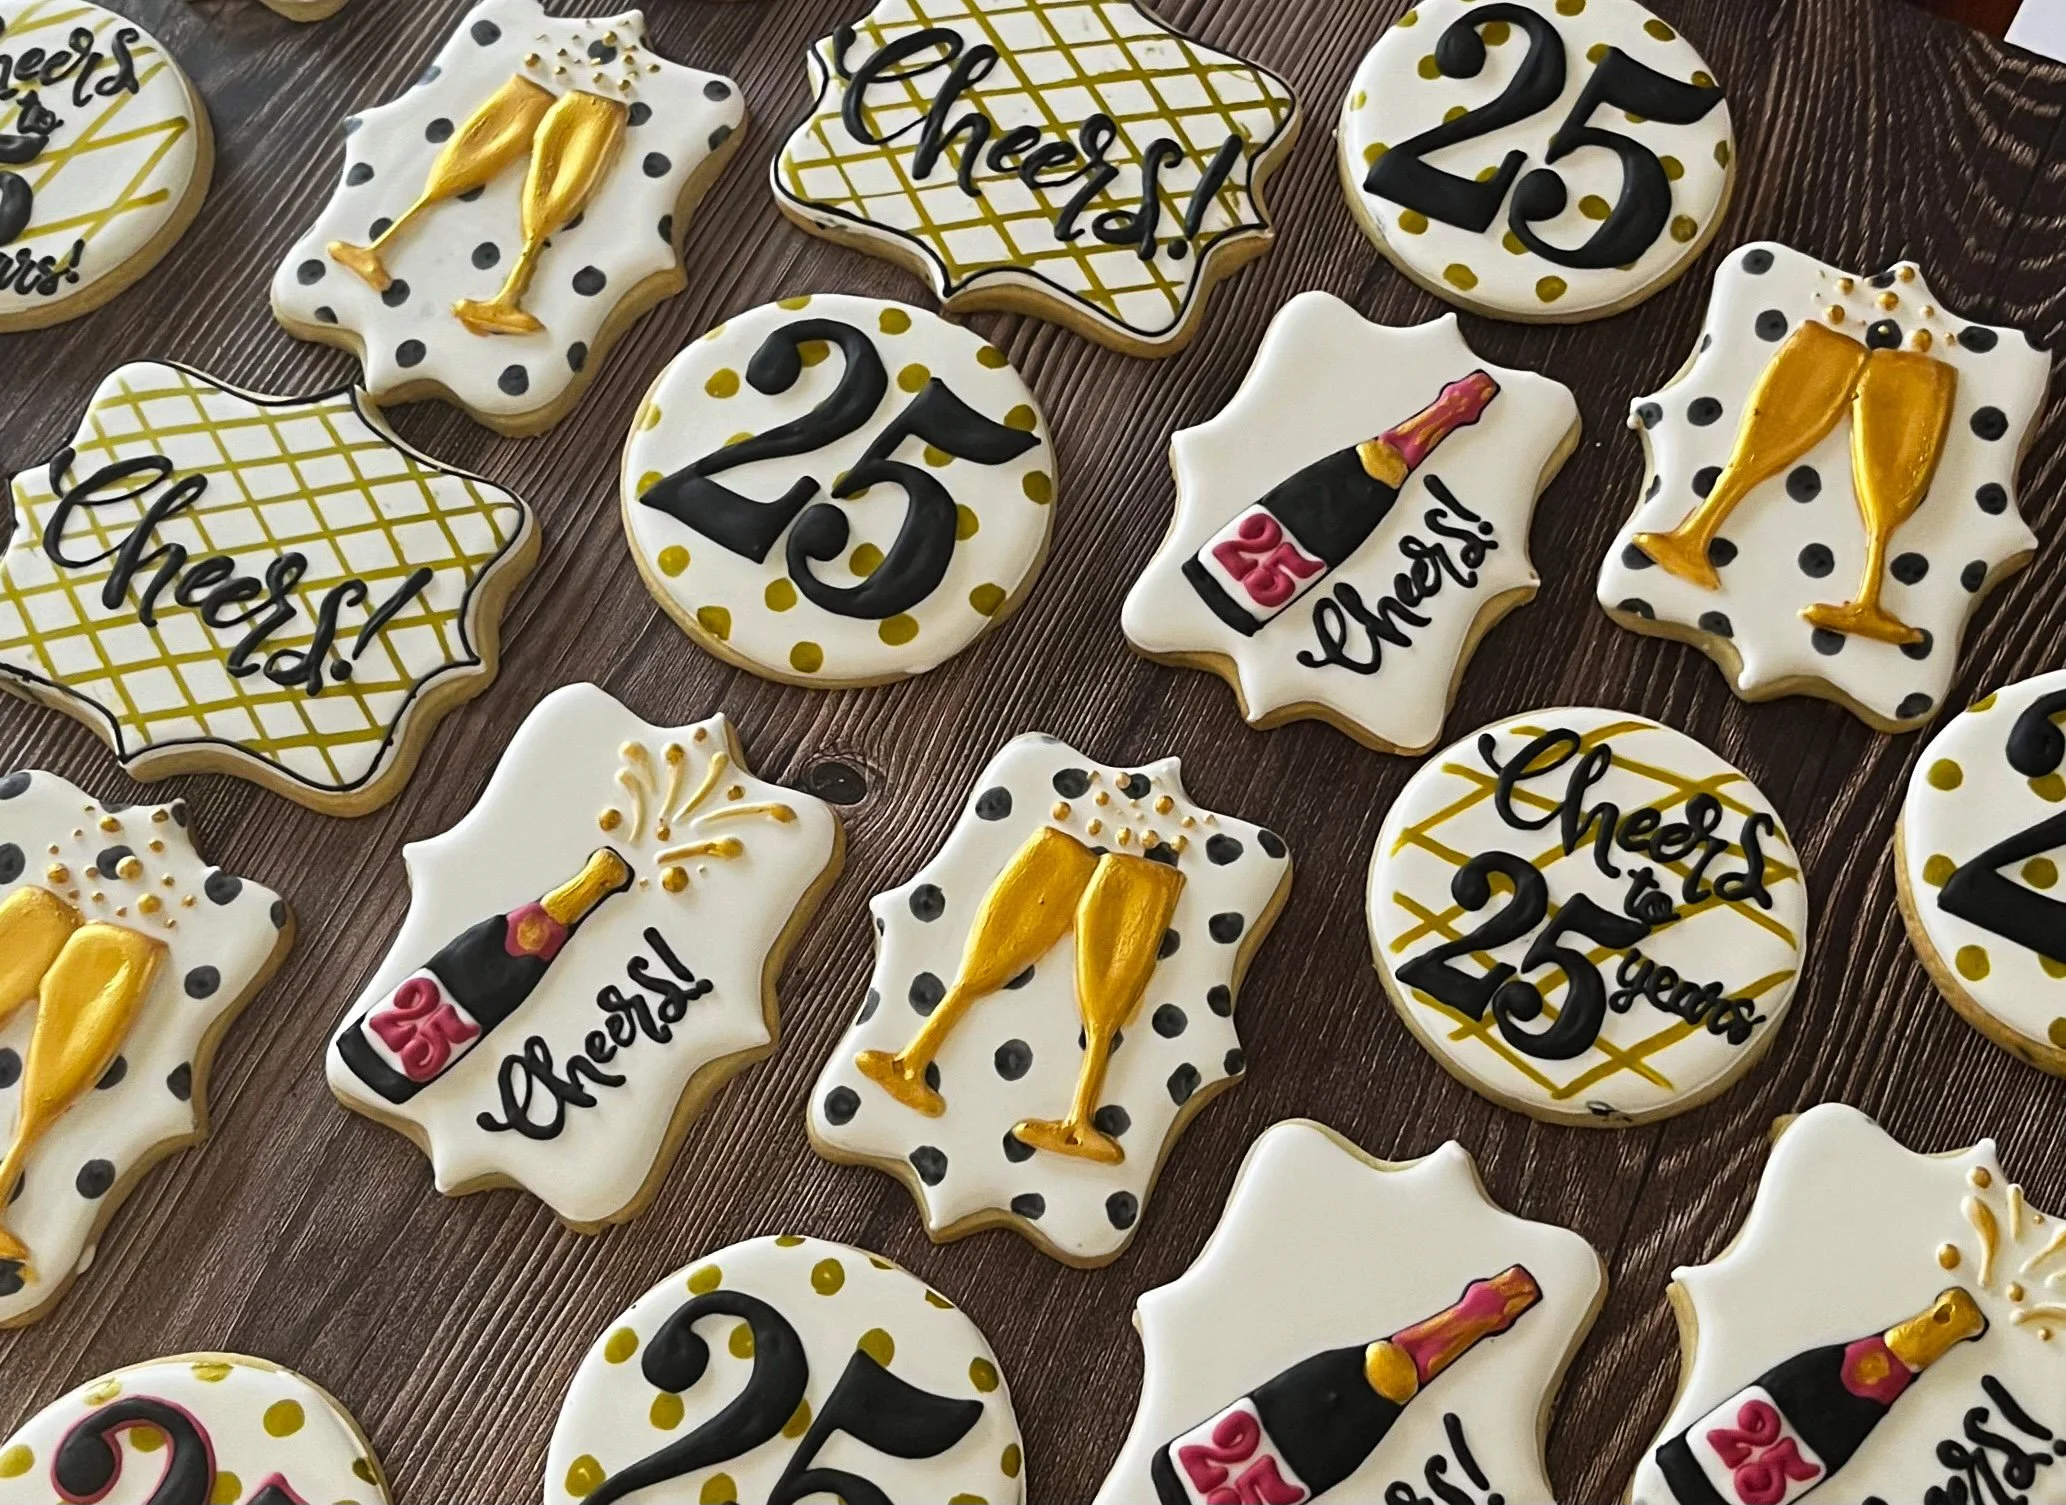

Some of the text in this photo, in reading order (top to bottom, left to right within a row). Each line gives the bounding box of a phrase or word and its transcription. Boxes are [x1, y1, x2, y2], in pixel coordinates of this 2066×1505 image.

[0, 15, 139, 108] eers
[833, 27, 1242, 260] Cheers!
[1363, 3, 1724, 269] 25
[639, 318, 1041, 619] 25
[1212, 513, 1327, 607] 25
[43, 447, 432, 696] Cheers!
[1296, 474, 1498, 674] Cheers!
[1478, 728, 1774, 908] Cheers
[1624, 866, 1681, 925] to
[369, 977, 481, 1082] 25
[477, 927, 713, 1140] Cheers!
[1395, 851, 1651, 1060] 25
[579, 1290, 984, 1505] 25
[1707, 1400, 1821, 1505] 25
